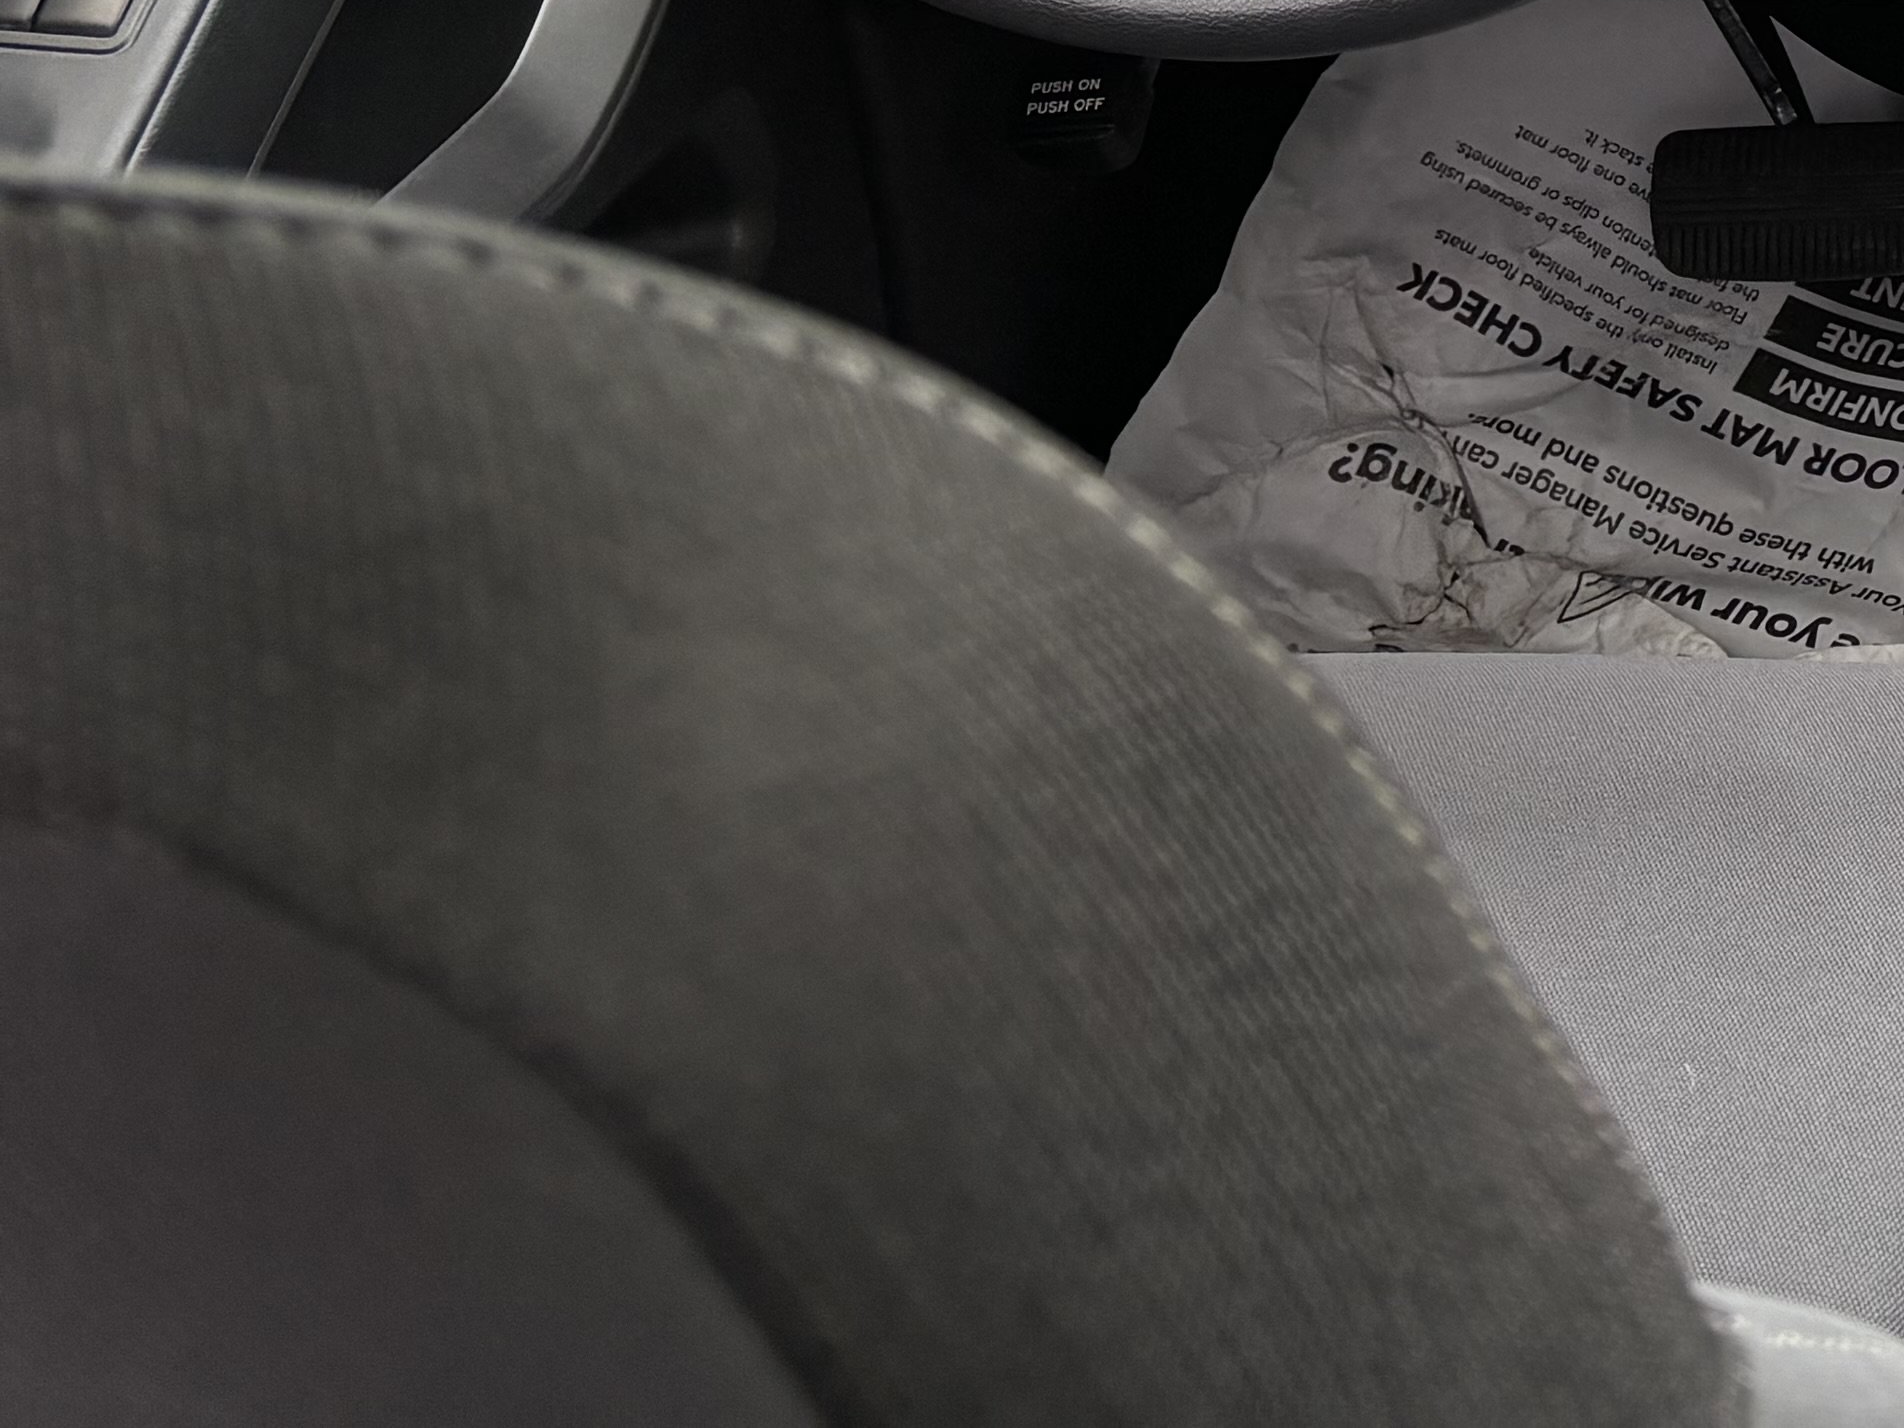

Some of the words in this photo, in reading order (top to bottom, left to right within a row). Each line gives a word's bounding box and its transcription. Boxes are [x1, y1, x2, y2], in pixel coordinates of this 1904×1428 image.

[1031, 80, 1074, 95] PUSH
[1078, 78, 1102, 91] ON
[1026, 99, 1070, 116] PUSH
[1074, 97, 1105, 112] OFF
[1514, 125, 1550, 146] mat
[1603, 138, 1645, 167] stack
[1420, 149, 1465, 184] using
[1551, 141, 1591, 173] floor
[1541, 184, 1562, 201] or
[1593, 165, 1627, 188] one
[1466, 176, 1534, 216] secured
[1562, 193, 1601, 221] clips
[1536, 211, 1558, 230] be
[1433, 228, 1479, 256] mats
[1559, 221, 1611, 261] always
[1480, 248, 1518, 282] floor
[1611, 254, 1669, 296] should
[1519, 273, 1595, 323] specified
[1585, 281, 1625, 309] your
[1671, 289, 1703, 306] mat
[1732, 283, 1759, 301] the
[1396, 263, 1543, 358] CHECK
[1624, 303, 1651, 326] for
[1705, 299, 1748, 325] Floor
[1595, 316, 1625, 340] the
[1649, 312, 1730, 353] designed
[1663, 342, 1719, 376] Install
[1542, 345, 1703, 422] SAFETY
[1467, 412, 1543, 447] more.
[1701, 408, 1801, 466] MAT
[1452, 435, 1500, 470] can
[1543, 438, 1600, 474] and
[1502, 460, 1626, 536] Manager
[1603, 464, 1734, 536] questions
[1629, 519, 1726, 569] Service
[1739, 527, 1812, 564] these
[1817, 546, 1875, 575] with
[1728, 555, 1852, 594] Assistant
[1711, 598, 1832, 648] your
